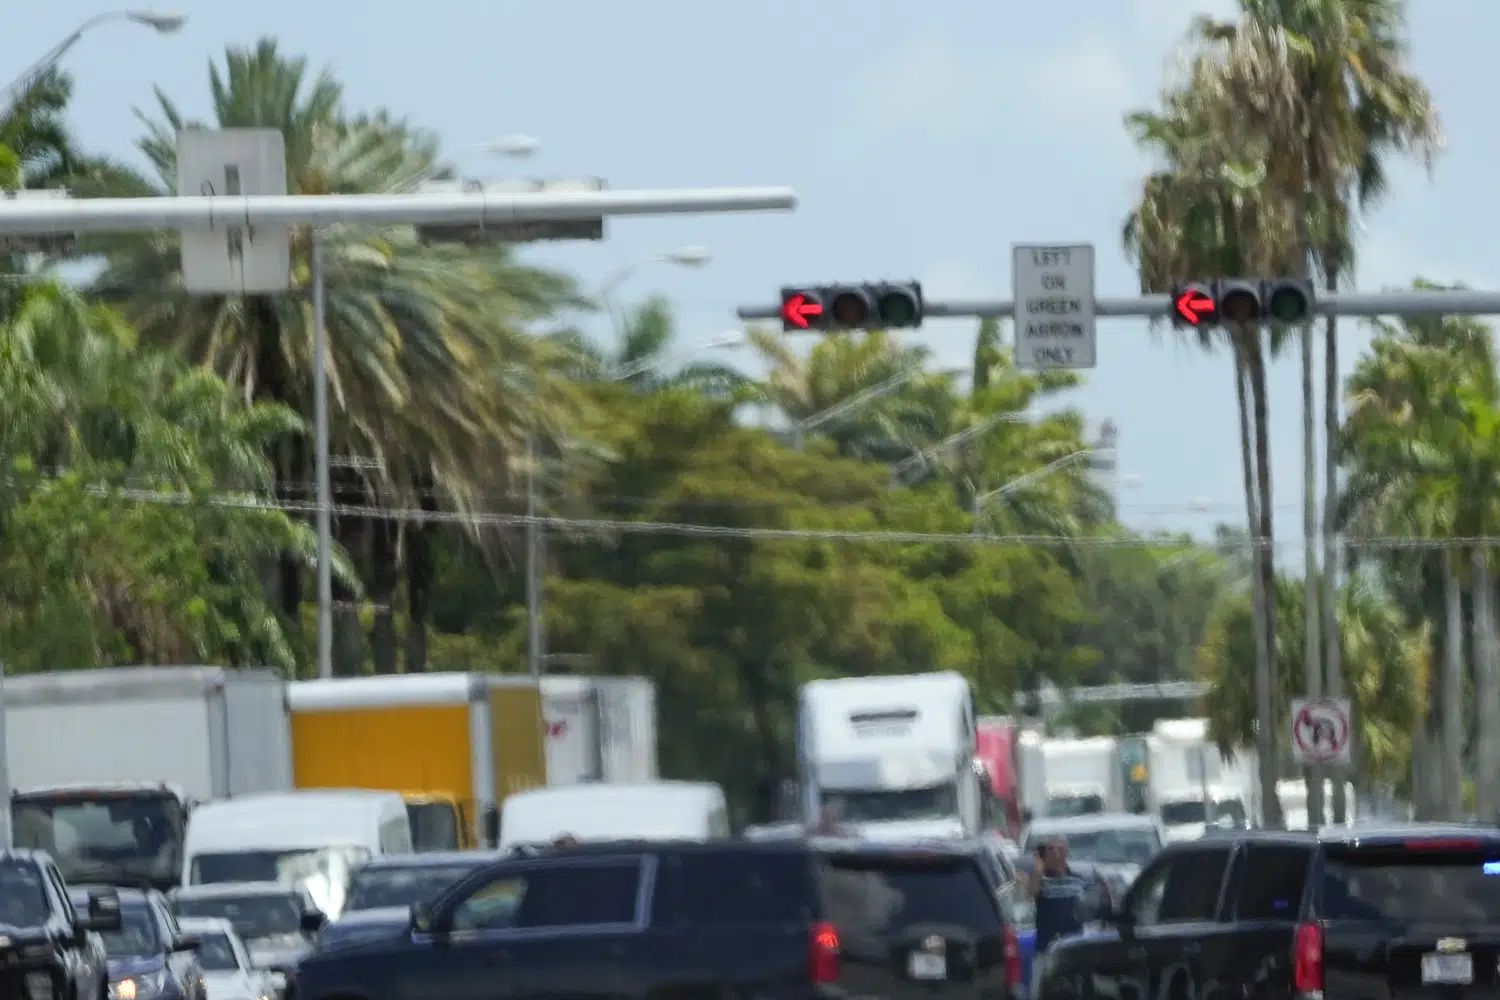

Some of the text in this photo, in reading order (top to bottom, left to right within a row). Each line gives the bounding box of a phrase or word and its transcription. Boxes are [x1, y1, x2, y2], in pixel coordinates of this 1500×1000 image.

[1033, 249, 1071, 266] LEFT
[1041, 272, 1065, 291] ON
[1026, 297, 1081, 314] GREEN
[1034, 345, 1073, 363] ONLY
